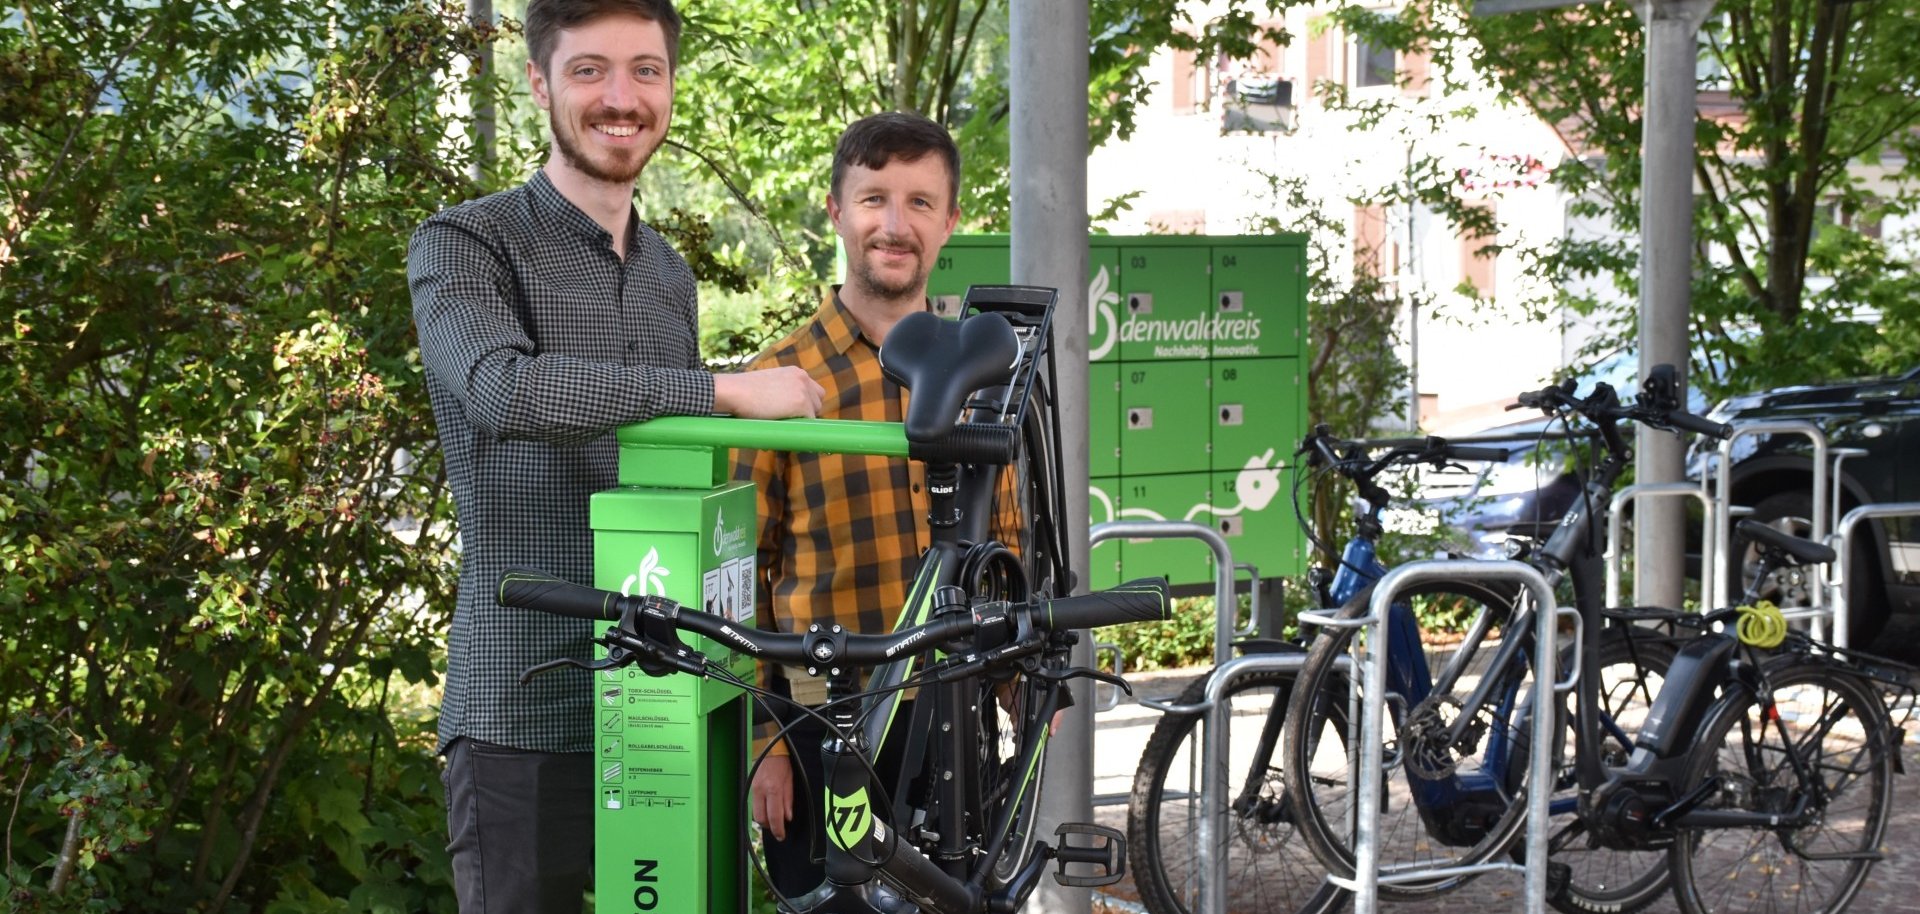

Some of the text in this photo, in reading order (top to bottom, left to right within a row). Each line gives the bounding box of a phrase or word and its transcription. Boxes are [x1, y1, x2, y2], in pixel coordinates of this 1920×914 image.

[938, 257, 953, 270] 01
[1131, 255, 1147, 269] 03
[1222, 255, 1237, 268] 04
[1131, 371, 1146, 384] 07
[1222, 368, 1238, 381] 08
[1133, 486, 1147, 498] 11
[1222, 480, 1236, 493] 12
[634, 859, 659, 914] ON
